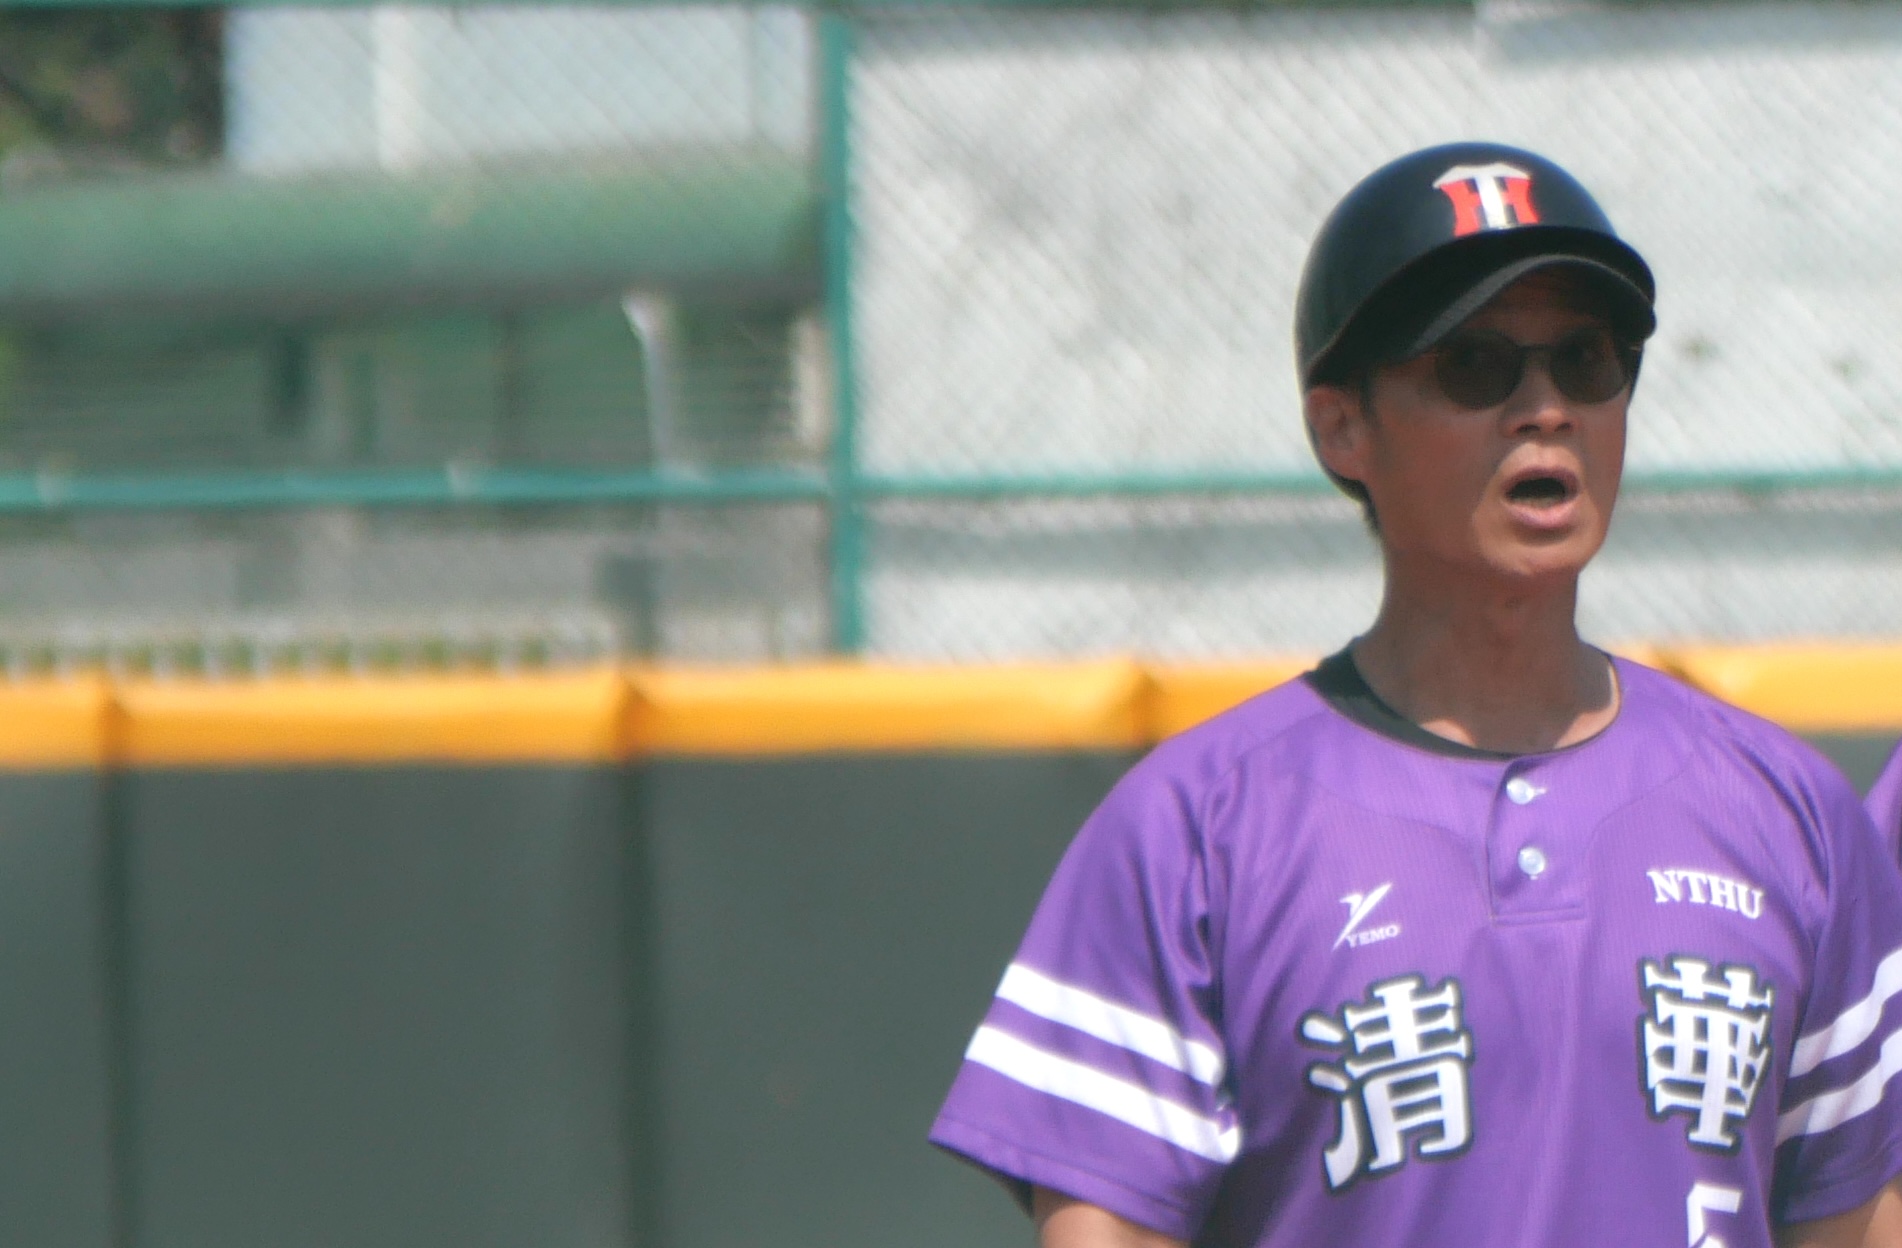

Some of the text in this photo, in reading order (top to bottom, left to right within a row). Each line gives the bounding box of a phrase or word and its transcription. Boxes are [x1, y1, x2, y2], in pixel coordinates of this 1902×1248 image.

[1646, 869, 1765, 919] NTHU
[1345, 924, 1399, 948] YEMO
[1299, 957, 1773, 1190] 清 華
